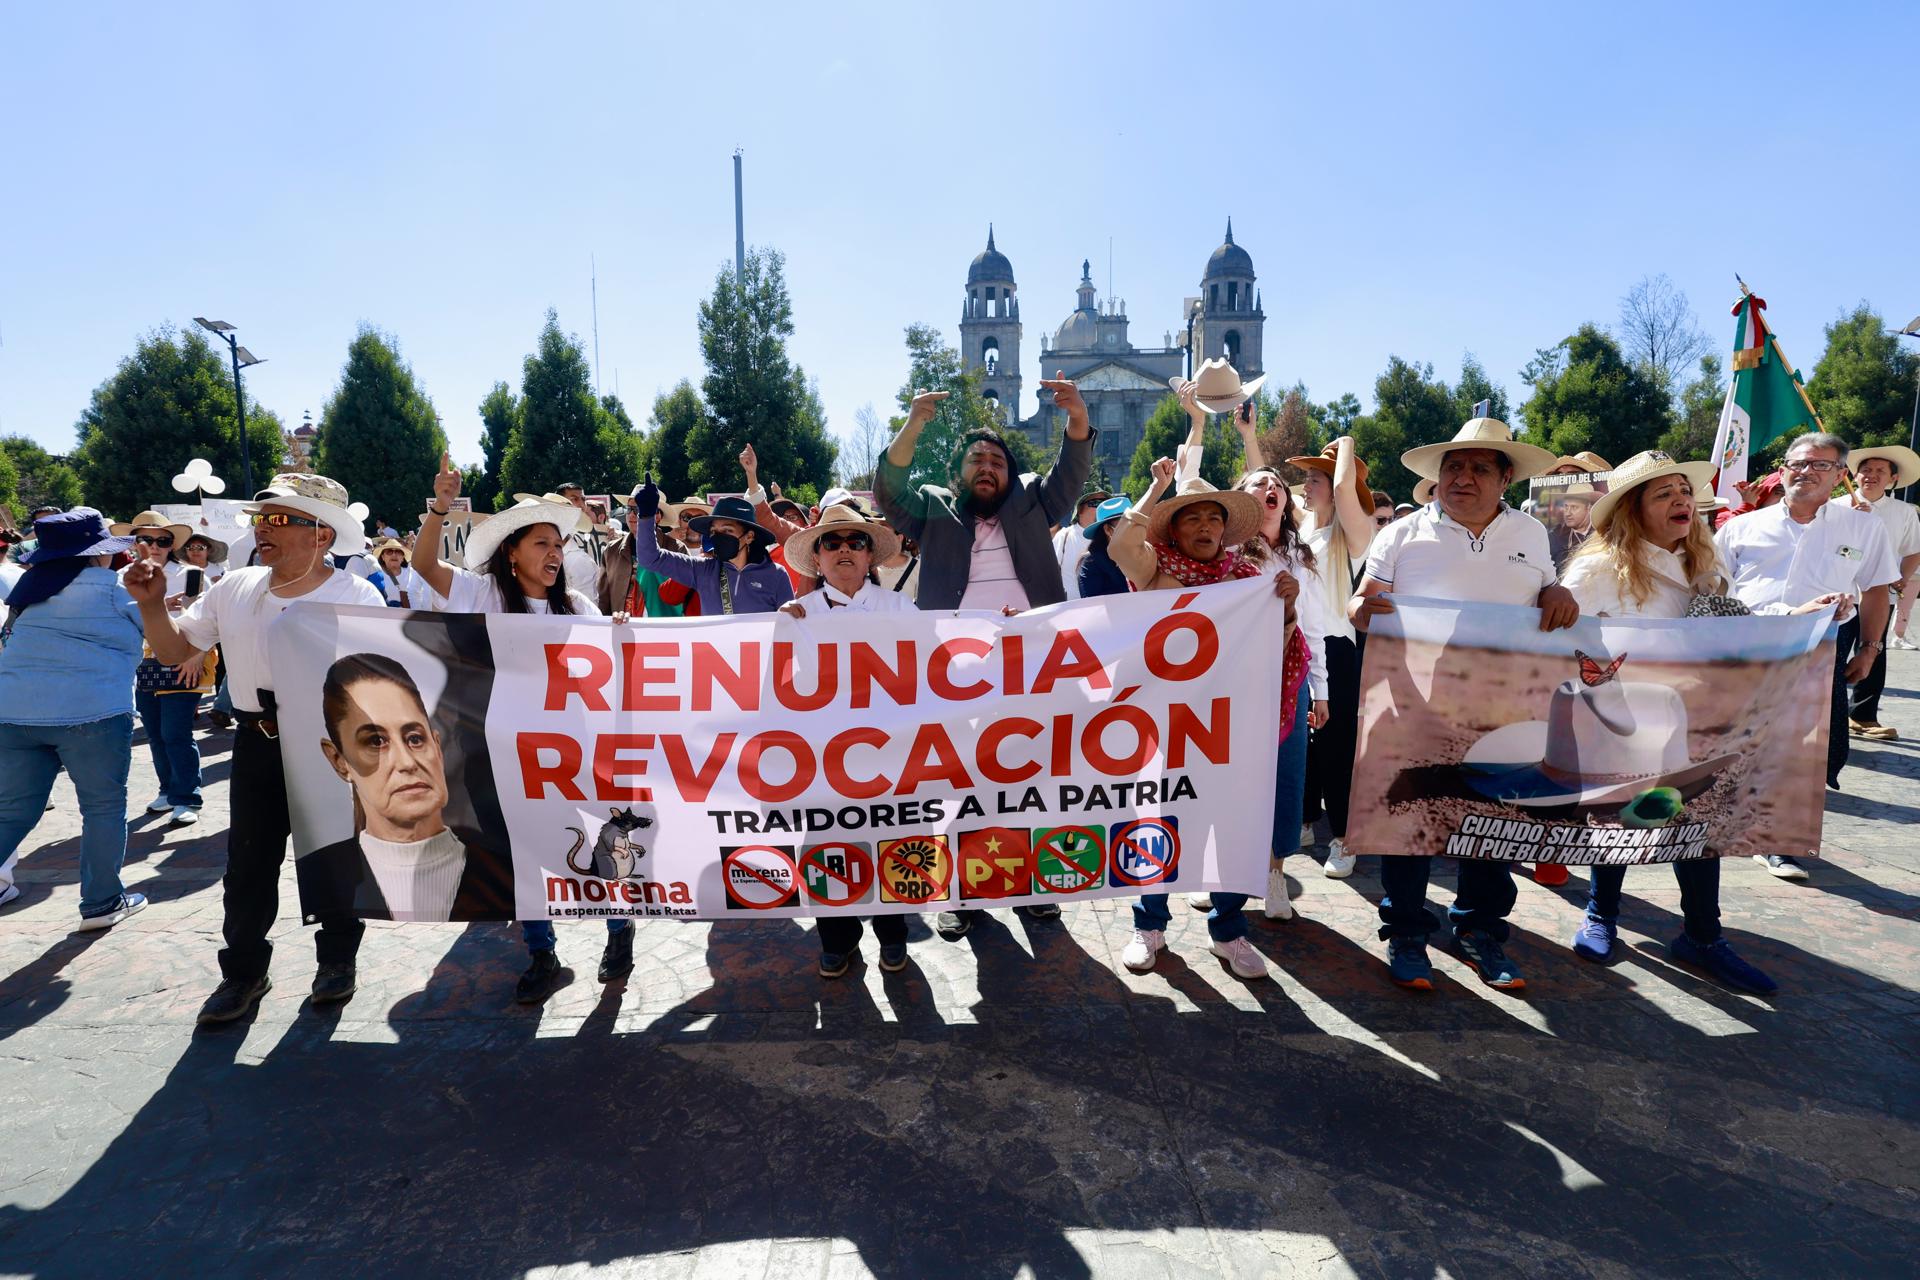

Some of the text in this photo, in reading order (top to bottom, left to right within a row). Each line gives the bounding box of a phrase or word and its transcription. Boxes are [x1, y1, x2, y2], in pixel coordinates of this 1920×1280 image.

[1530, 474, 1577, 488] MOVIMIENTO
[1578, 472, 1592, 484] DEL
[543, 592, 1219, 711] RENUNCIA Ó
[516, 685, 1231, 803] REVOCACIÓN
[707, 775, 1198, 834] TRAIDORES A LA PATRIA
[1461, 814, 1710, 848] CUANDO SILENCIEN MI VOZ
[1123, 834, 1165, 870] PAN
[1446, 834, 1477, 857] MI
[1477, 837, 1557, 864] PUEBLO
[1554, 845, 1646, 866] HABLARA
[1644, 844, 1686, 864] POR
[807, 854, 861, 886] PRI
[965, 857, 1025, 894] PT
[546, 876, 693, 904] morena
[548, 905, 697, 918] La esperanza de las Ratas
